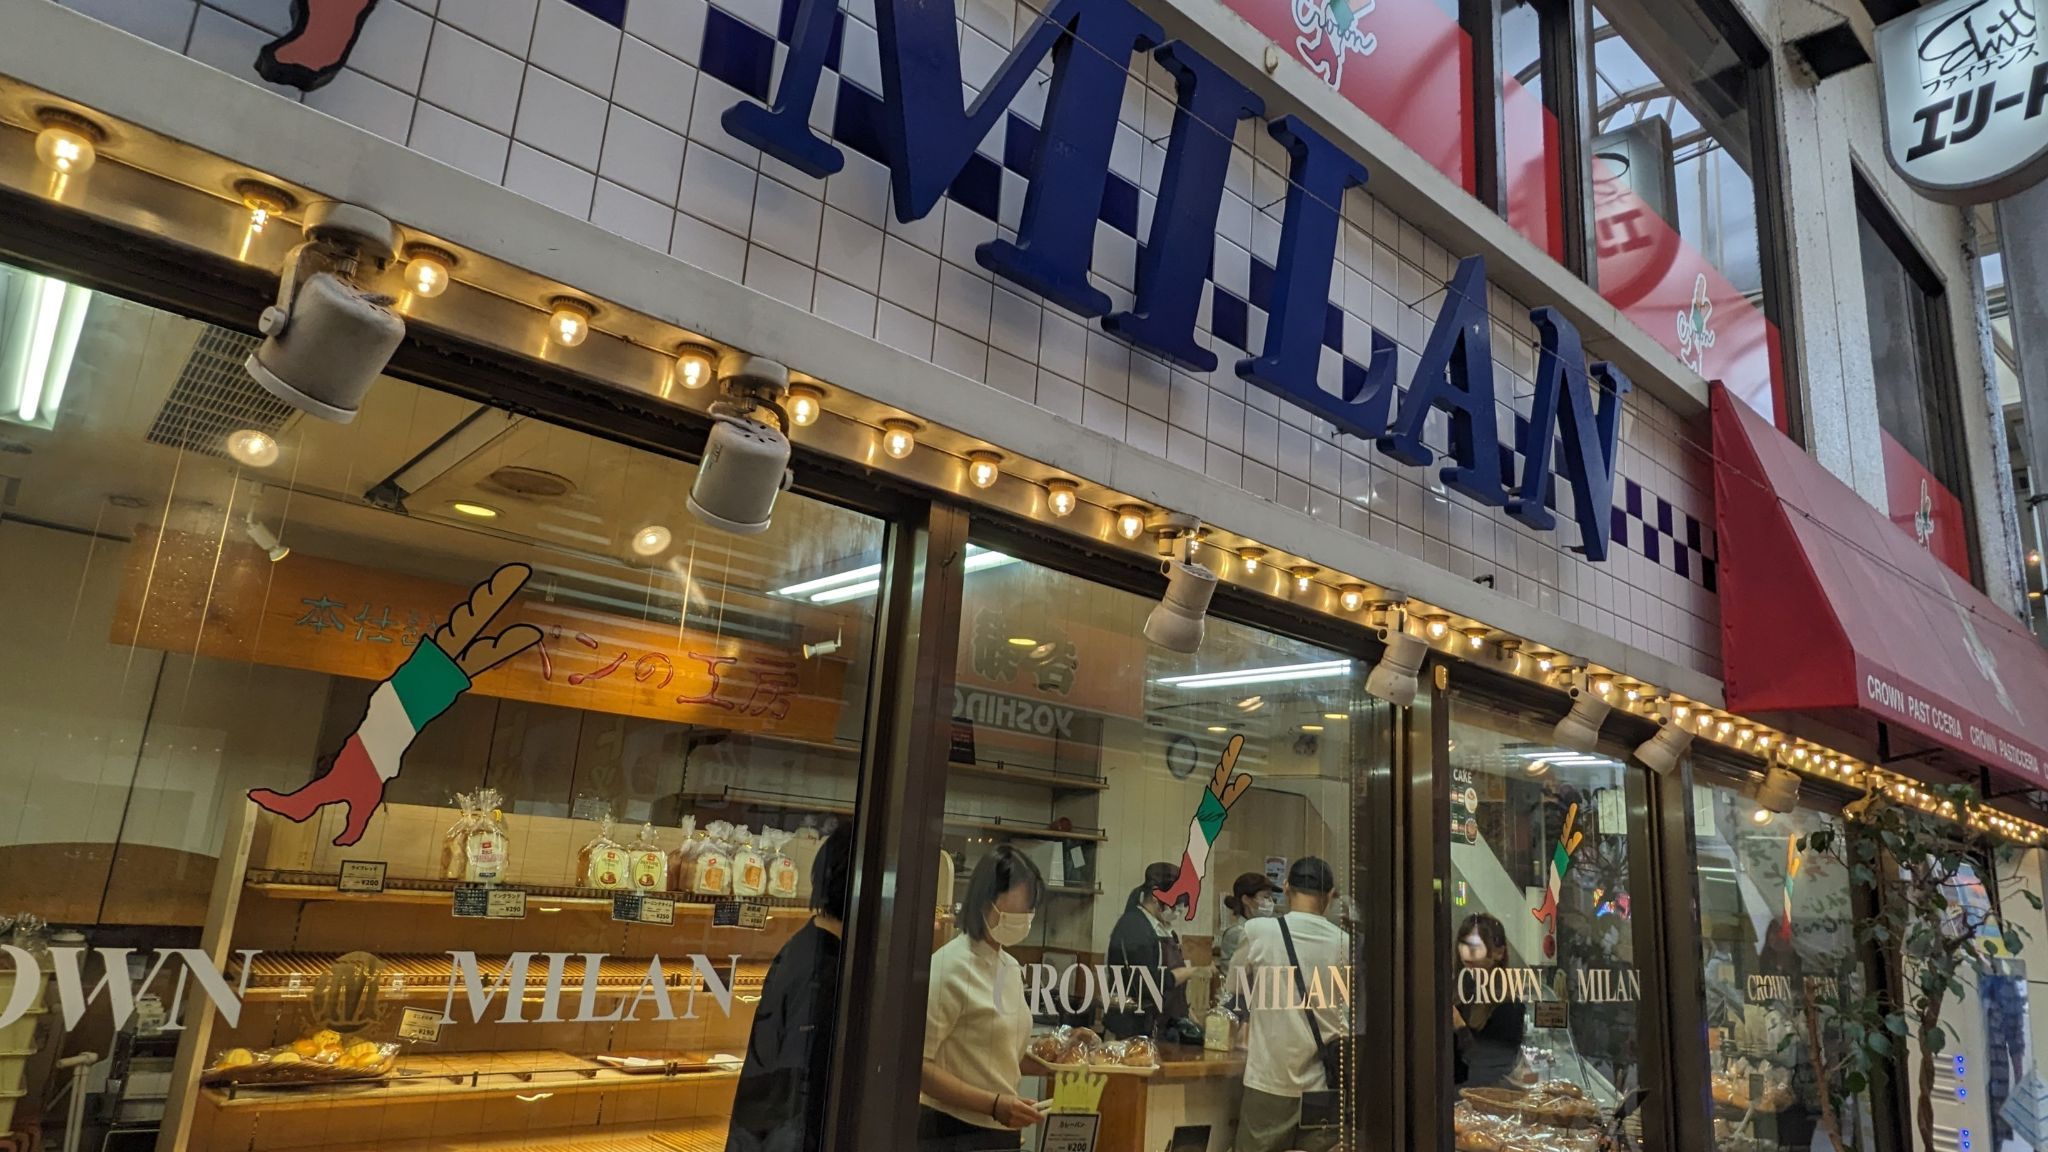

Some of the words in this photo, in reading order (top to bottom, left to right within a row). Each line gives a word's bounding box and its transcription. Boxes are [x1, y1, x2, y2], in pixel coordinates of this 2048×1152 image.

[1922, 43, 2039, 97] ファイナンス
[722, 0, 1631, 560] MILAN
[1867, 674, 1905, 714] CROWN
[1969, 725, 1998, 755] CROWN
[1453, 768, 1473, 785] CAKE
[361, 879, 379, 887] ¥200
[436, 950, 742, 1025] MILAN
[993, 963, 1168, 1016] CROWN
[1233, 965, 1351, 1012] MILAN
[1457, 967, 1543, 1004] CROWN
[1575, 968, 1642, 1002] MILAN
[1747, 974, 1792, 1001] CROWN
